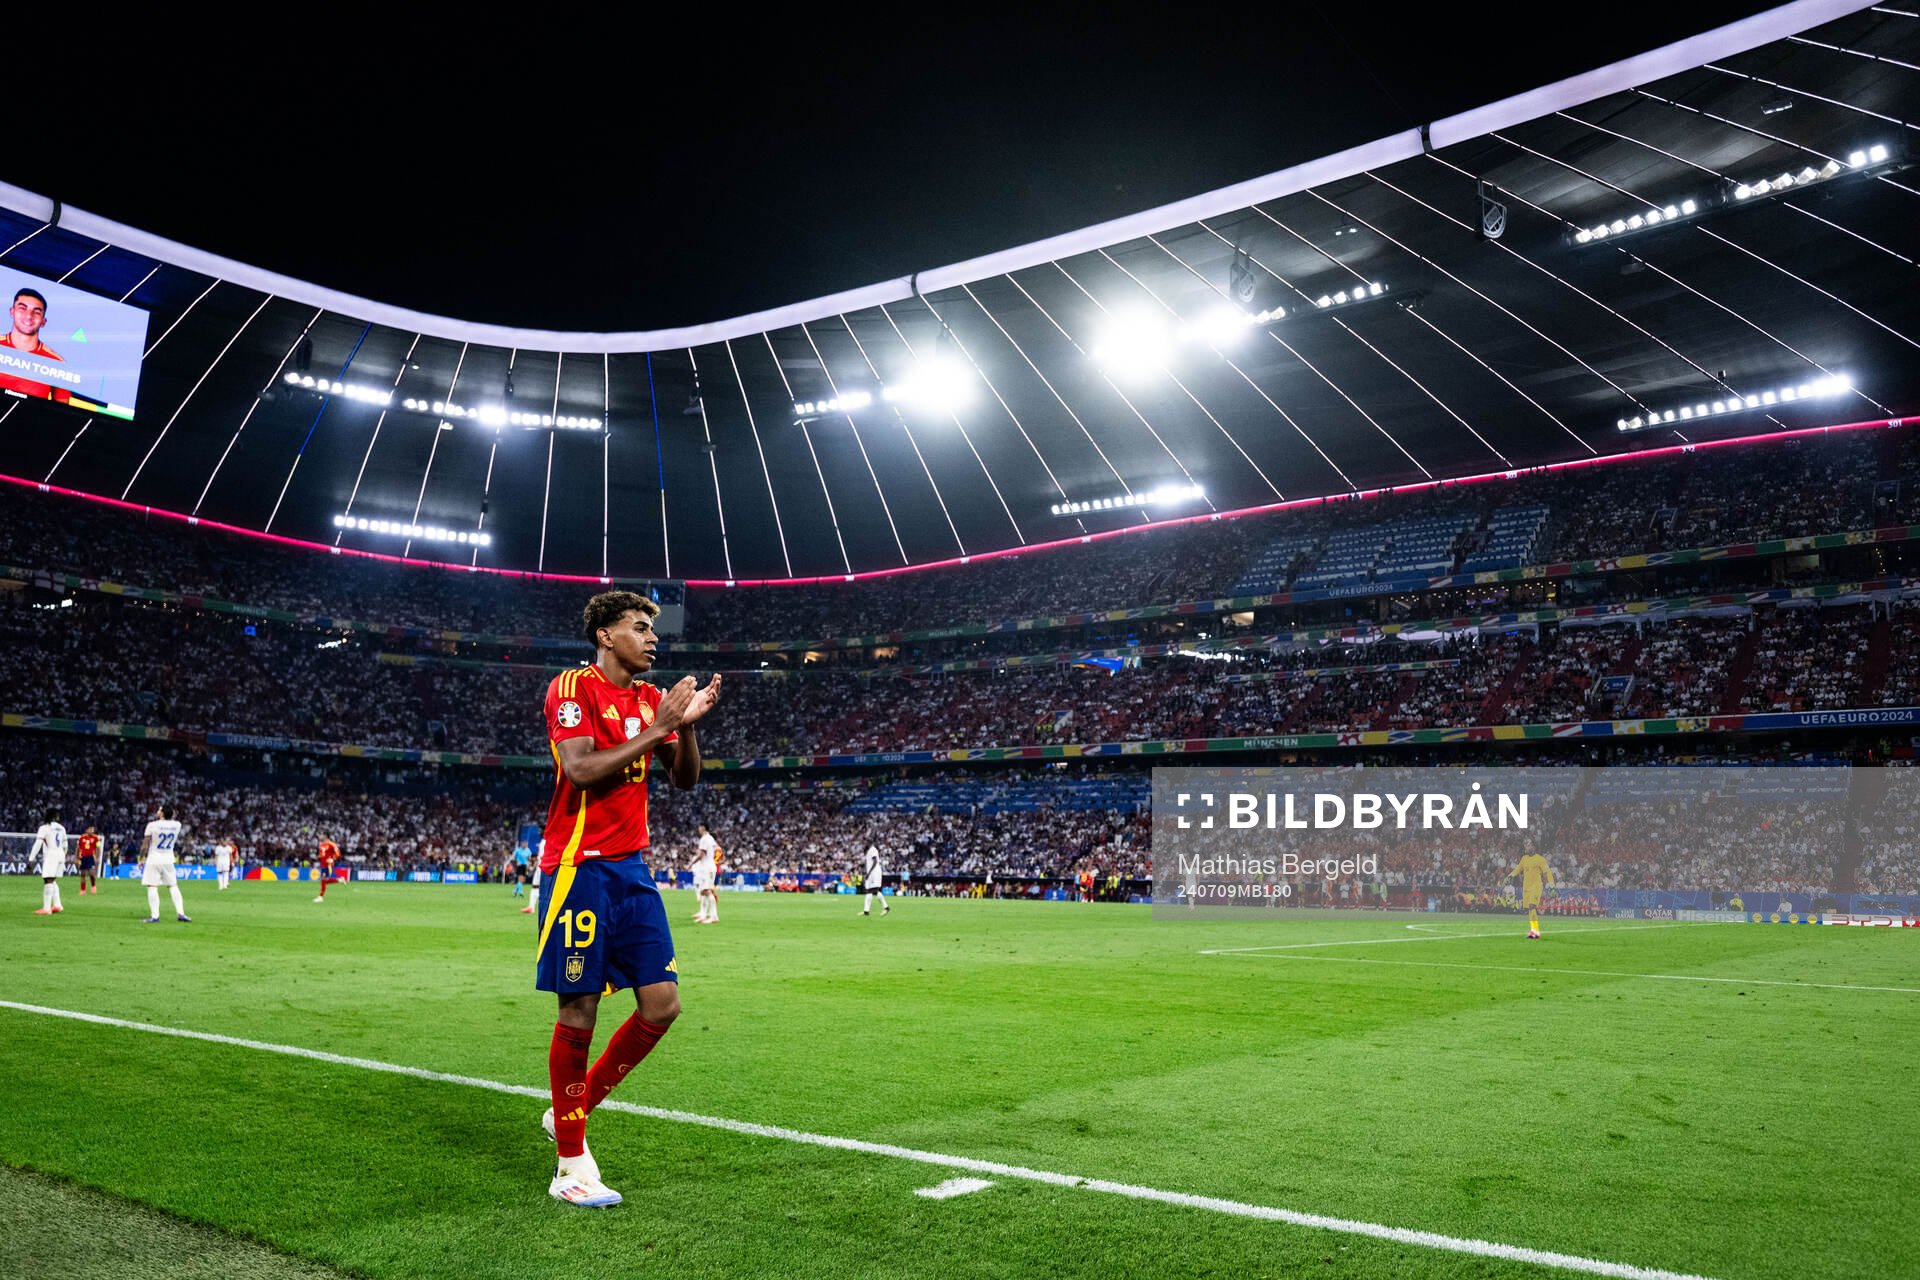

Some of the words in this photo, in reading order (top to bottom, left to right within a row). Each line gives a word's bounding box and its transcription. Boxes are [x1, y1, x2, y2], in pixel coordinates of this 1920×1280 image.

[32, 362, 81, 384] TORRES
[157, 832, 175, 849] 22
[1645, 909, 1673, 918] QATAR
[1679, 909, 1745, 921] Hisense
[558, 909, 597, 948] 19
